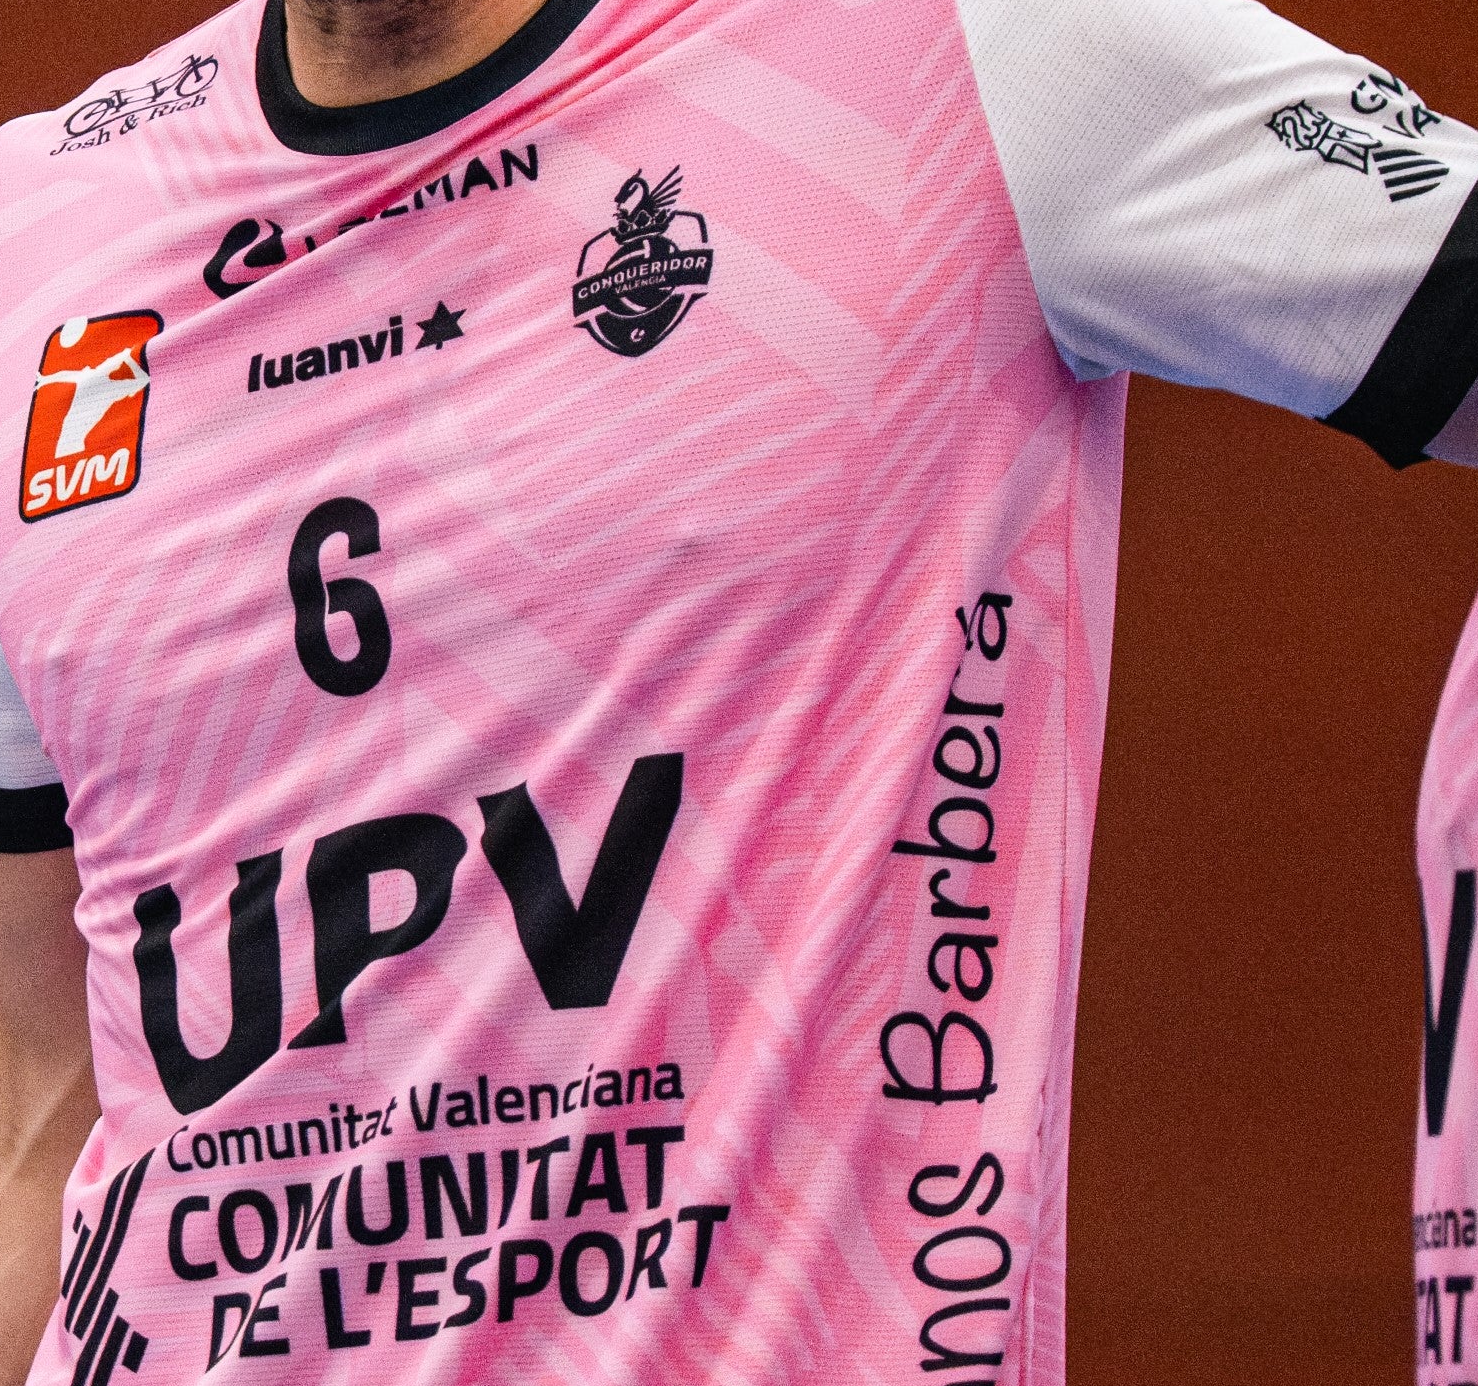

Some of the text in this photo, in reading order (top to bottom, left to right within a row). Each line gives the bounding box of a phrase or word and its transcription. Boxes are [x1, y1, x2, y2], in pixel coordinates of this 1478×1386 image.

[49, 95, 207, 156] Josh & Rich
[577, 256, 708, 300] CONQUERIDOR
[247, 315, 405, 393] luanvi
[26, 447, 130, 512] SVM
[286, 496, 392, 697] 6
[133, 751, 685, 1117] UPV
[166, 1062, 685, 1175] Comunitat Valenciana
[167, 1125, 686, 1283] COMUNITAT
[205, 1203, 732, 1376] DE L'ESPORT
